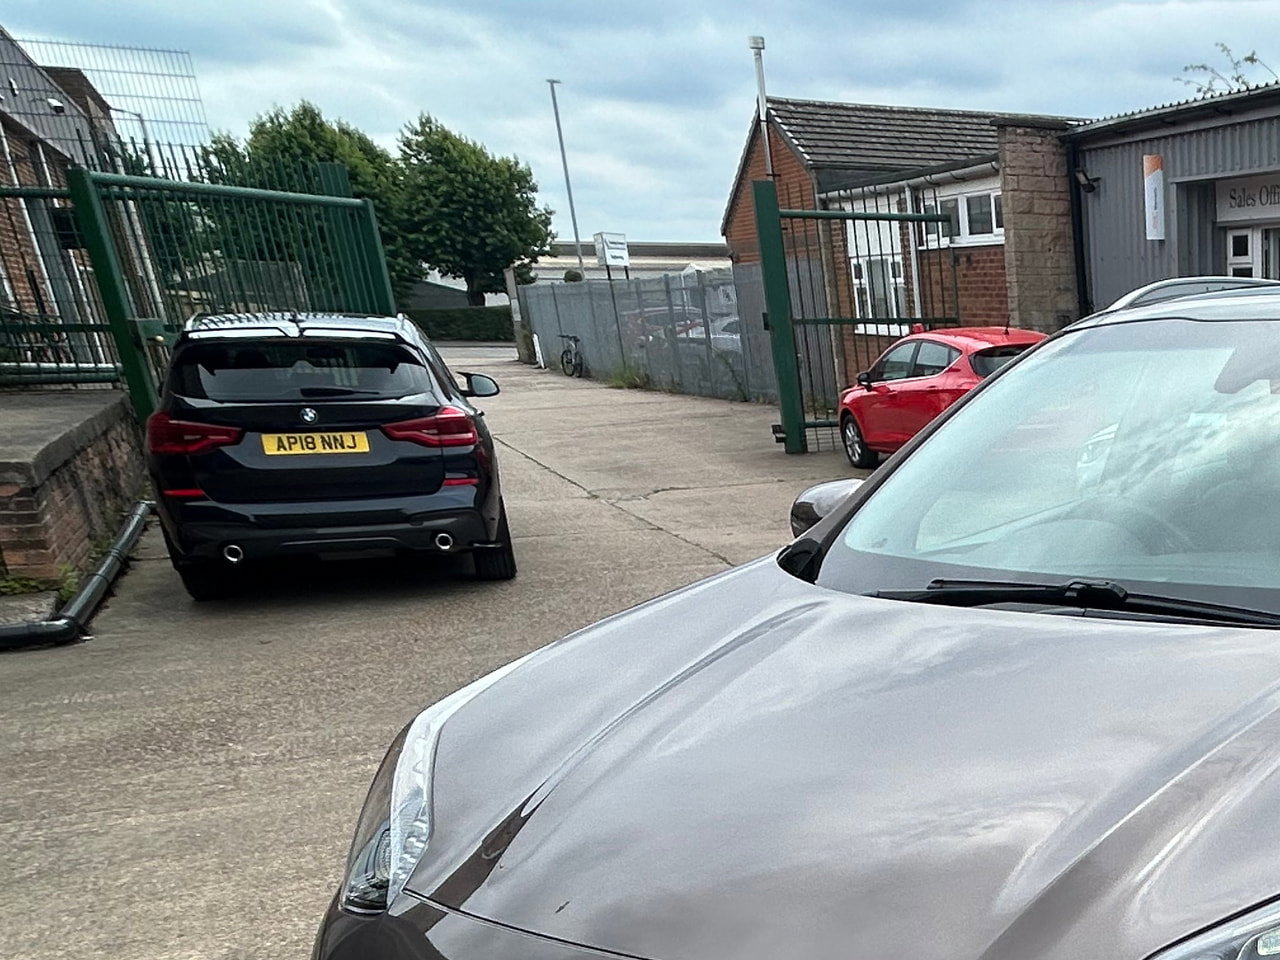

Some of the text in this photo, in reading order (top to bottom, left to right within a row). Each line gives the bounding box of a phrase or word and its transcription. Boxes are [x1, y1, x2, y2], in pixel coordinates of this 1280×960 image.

[1229, 188, 1257, 209] Sales
[276, 434, 357, 452] AP18 NNJ
